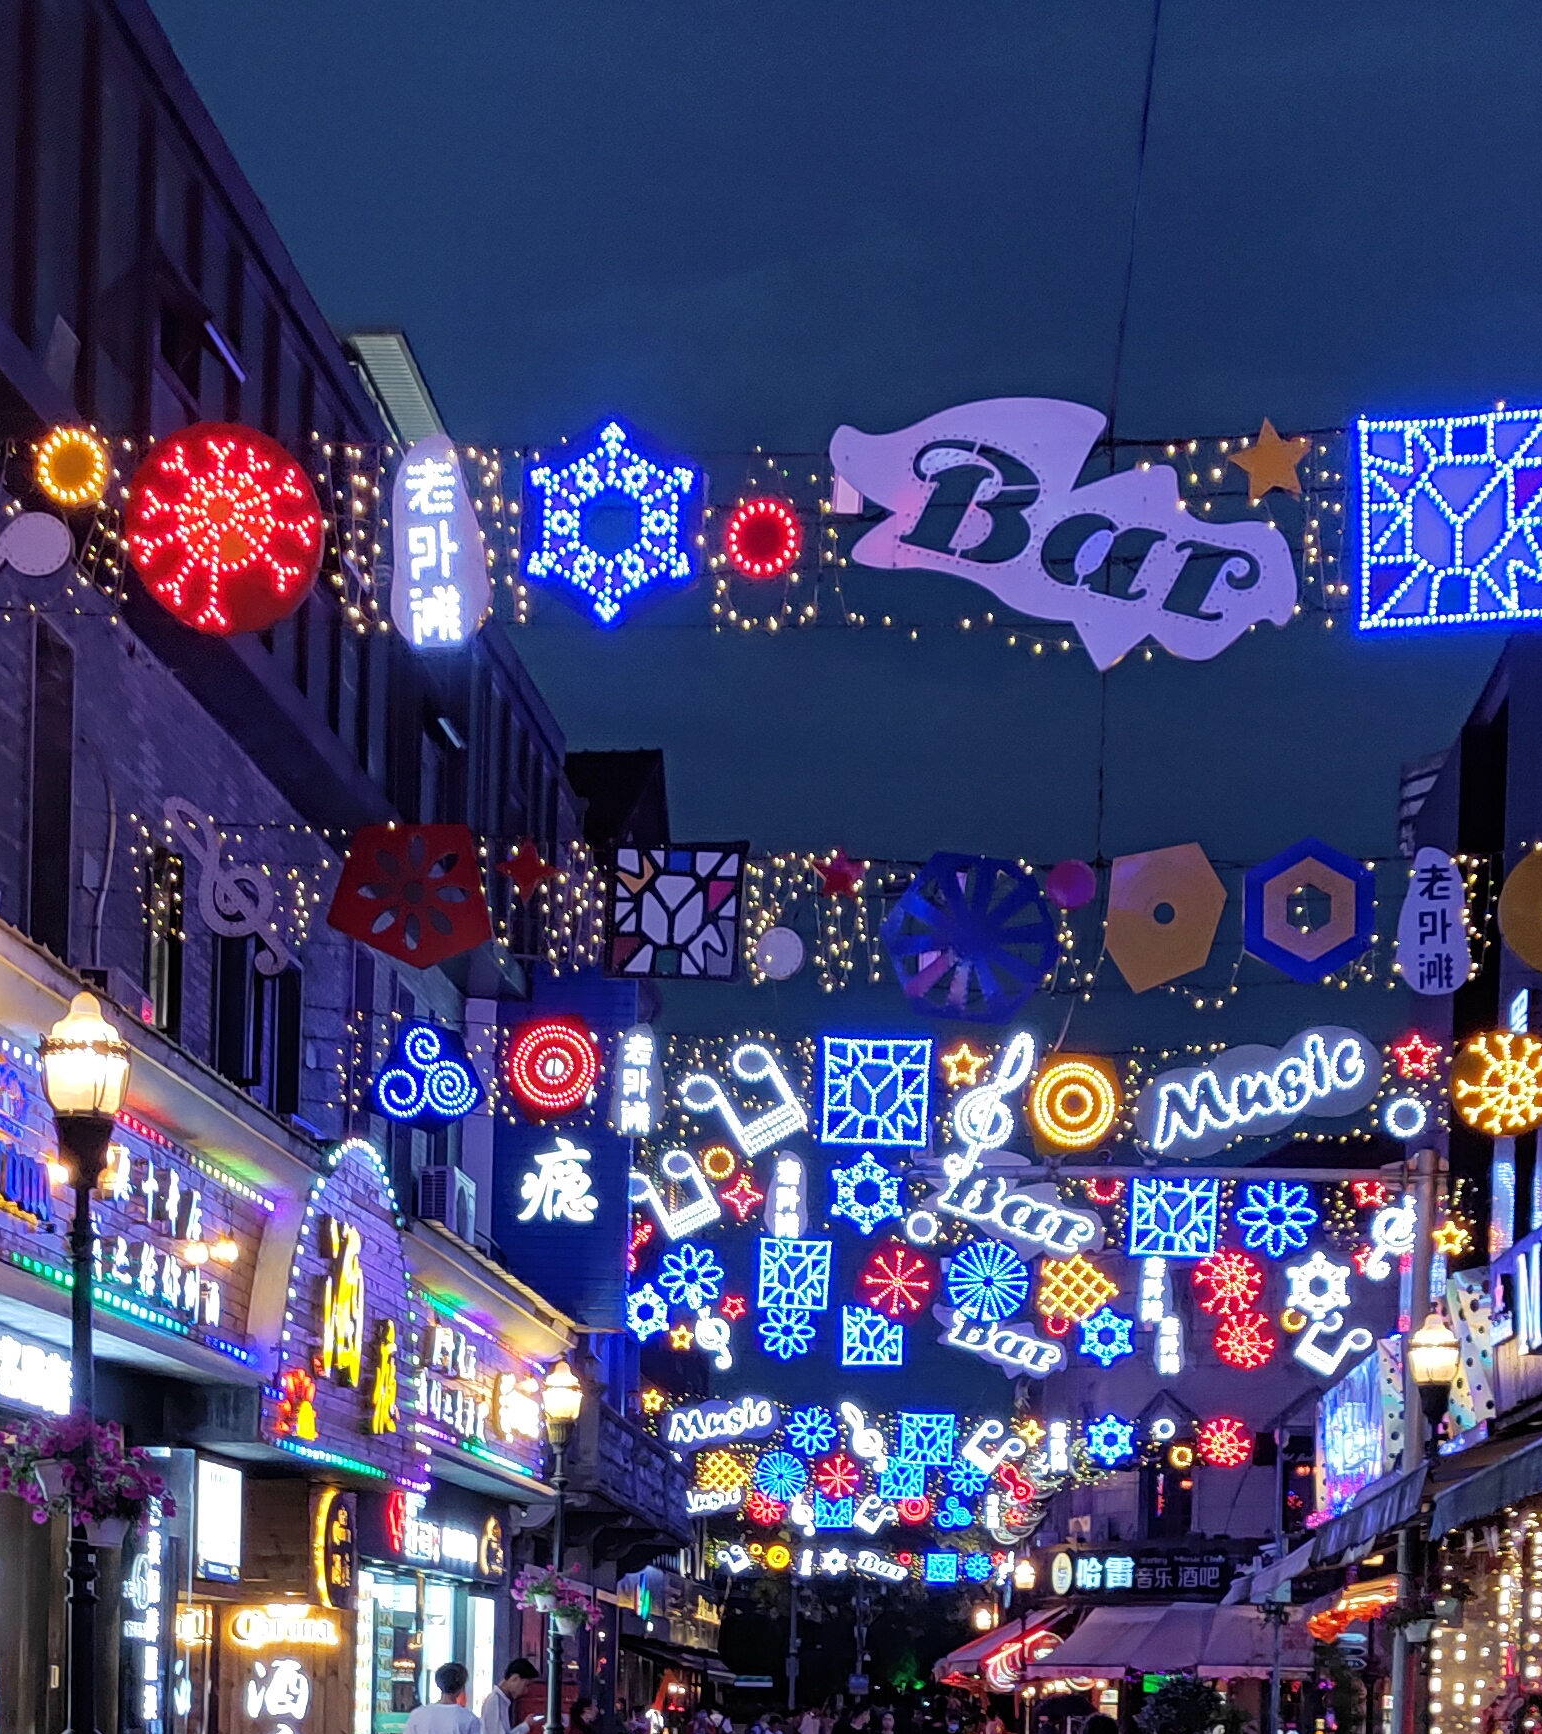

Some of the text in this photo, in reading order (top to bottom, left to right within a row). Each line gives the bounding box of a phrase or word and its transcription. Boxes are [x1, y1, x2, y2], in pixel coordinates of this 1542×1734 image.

[900, 437, 1262, 622] Bar
[1153, 1032, 1365, 1151] Music
[667, 1397, 773, 1443] Music
